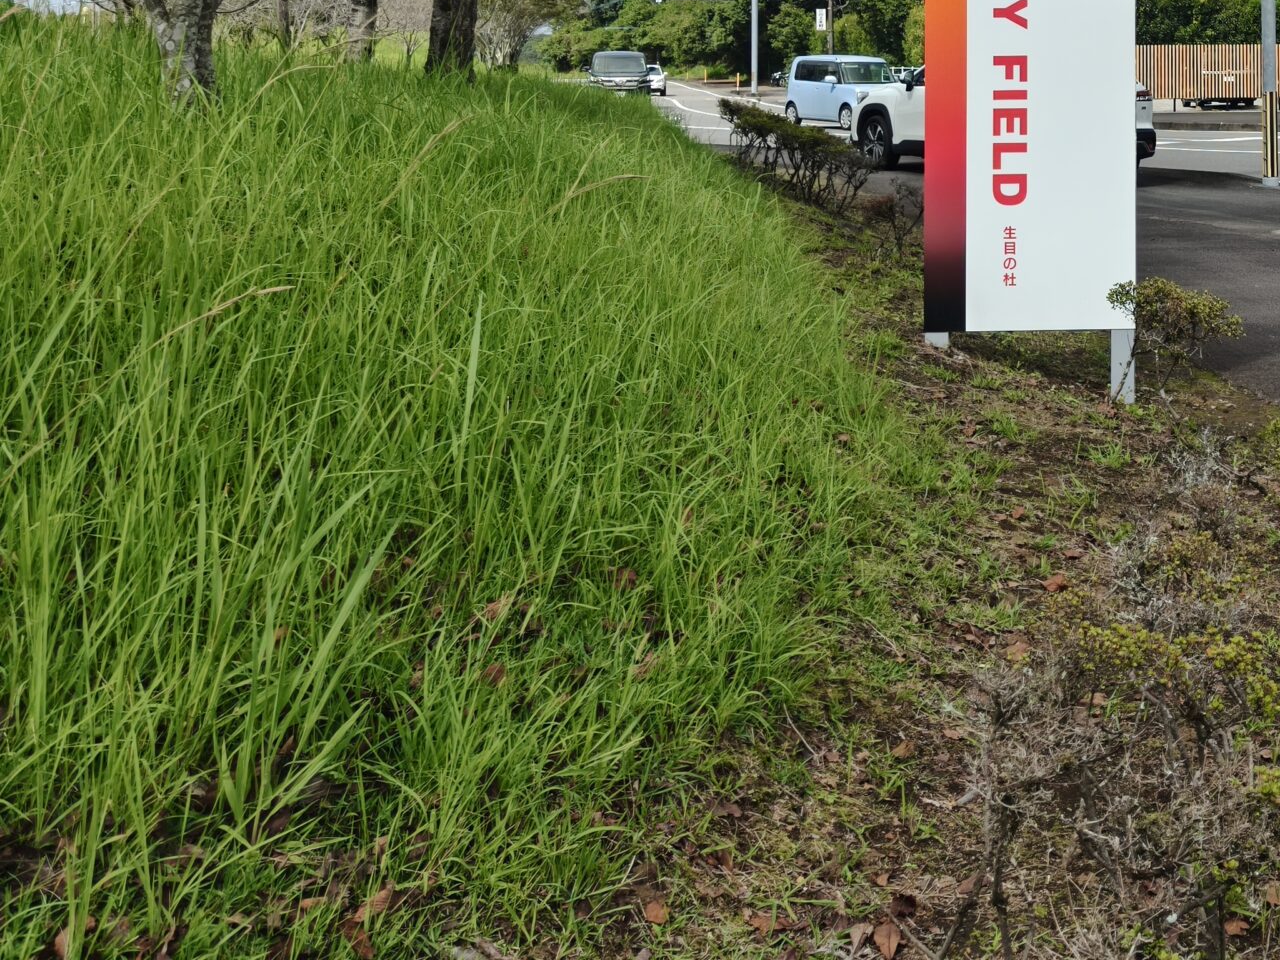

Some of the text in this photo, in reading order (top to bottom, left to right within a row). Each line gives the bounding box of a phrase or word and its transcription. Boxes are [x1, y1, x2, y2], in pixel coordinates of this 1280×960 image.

[992, 55, 1028, 206] FIELD
[1003, 226, 1016, 287] 生目の杜
